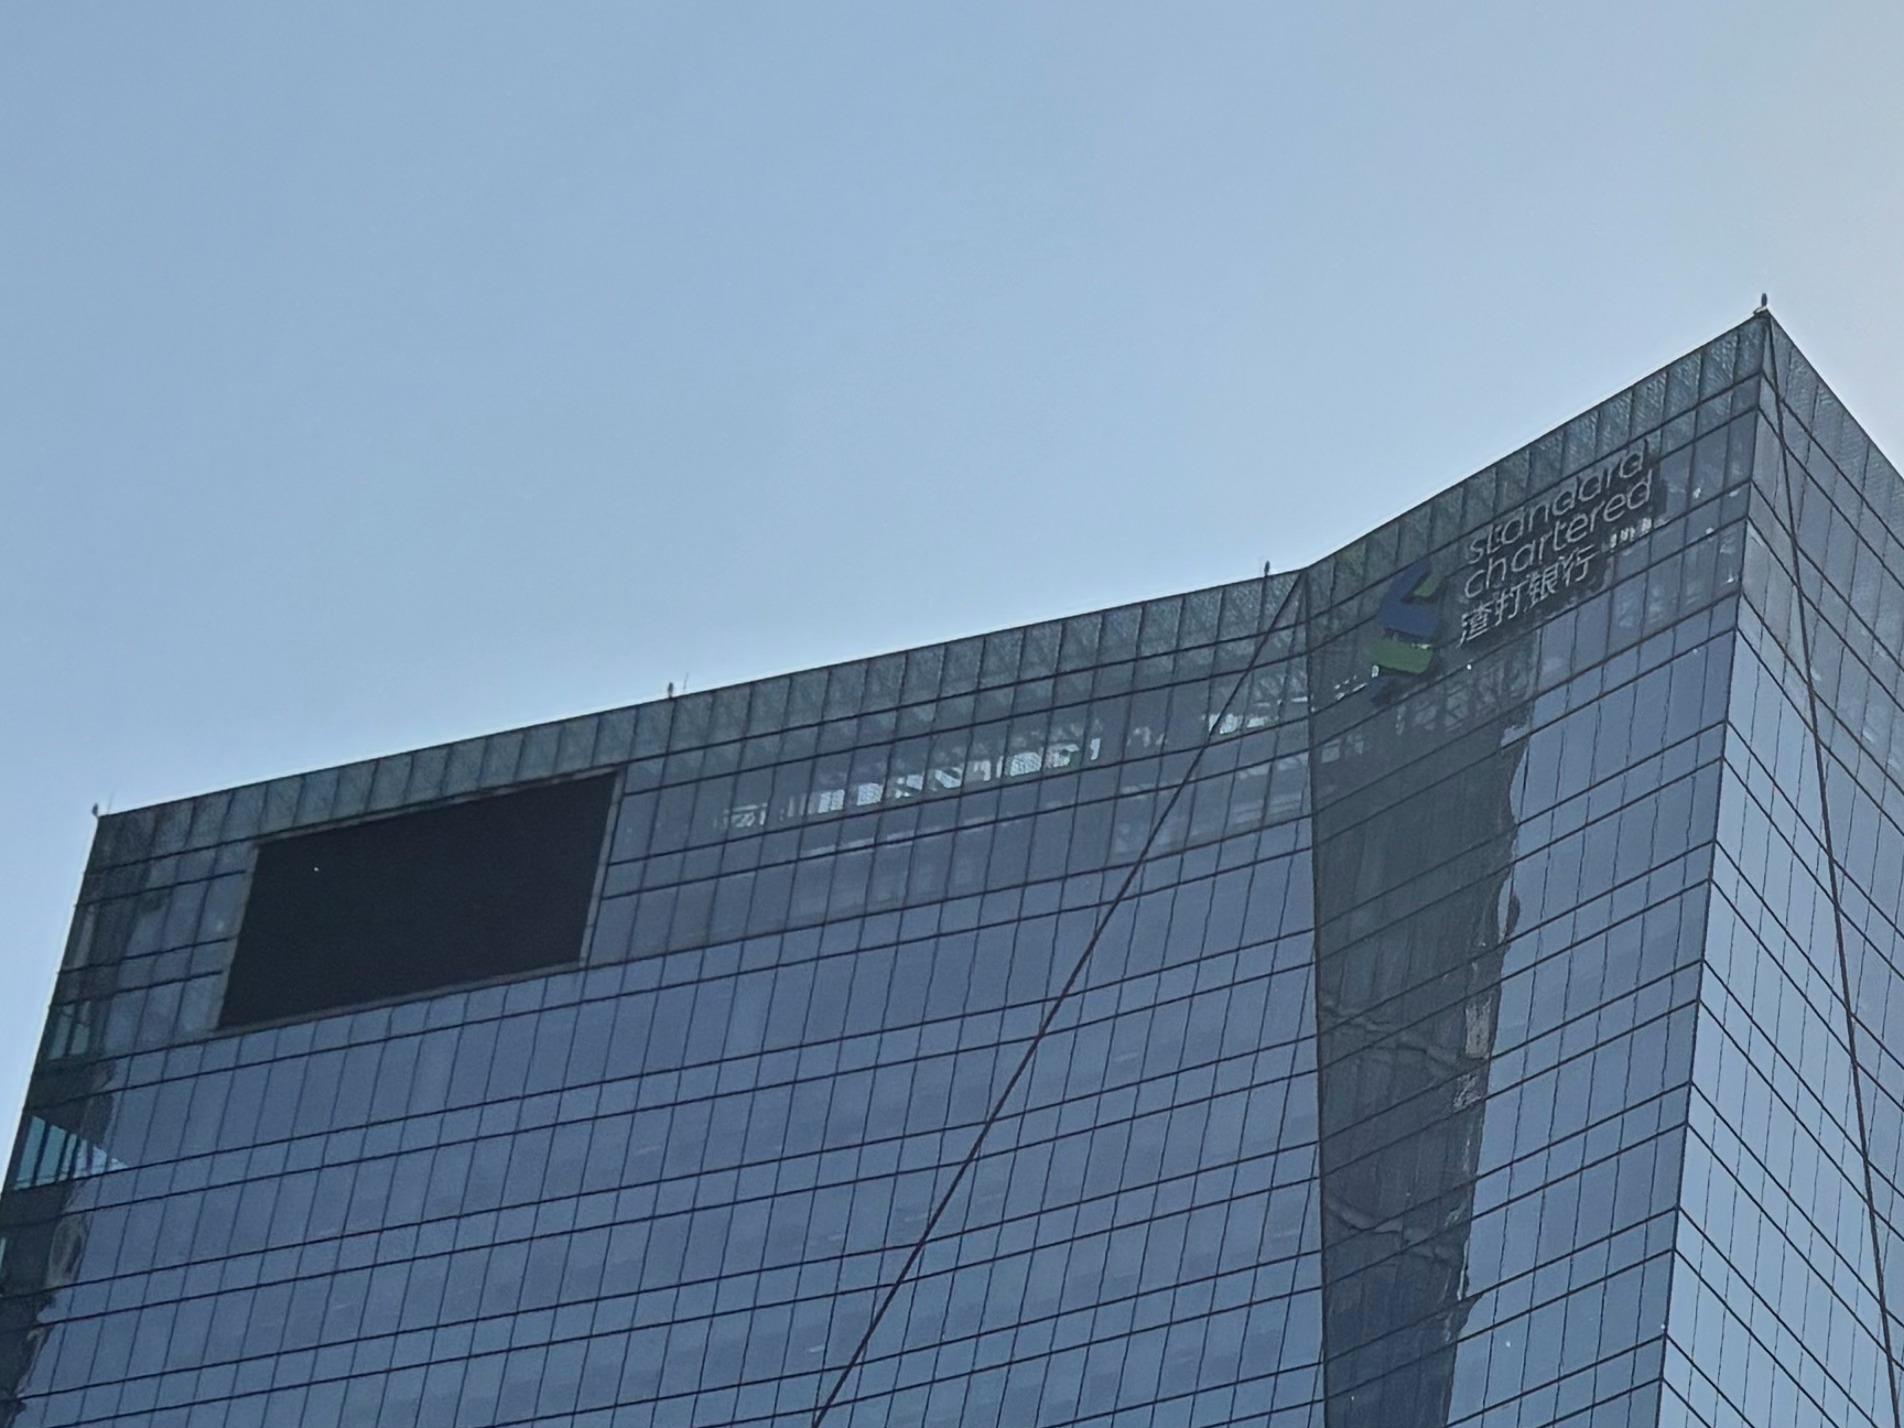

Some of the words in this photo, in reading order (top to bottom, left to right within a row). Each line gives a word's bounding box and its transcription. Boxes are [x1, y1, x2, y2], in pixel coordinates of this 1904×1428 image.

[1464, 469, 1653, 598] chartered
[1468, 440, 1647, 564] standard
[1457, 544, 1597, 649] 渣打银行
